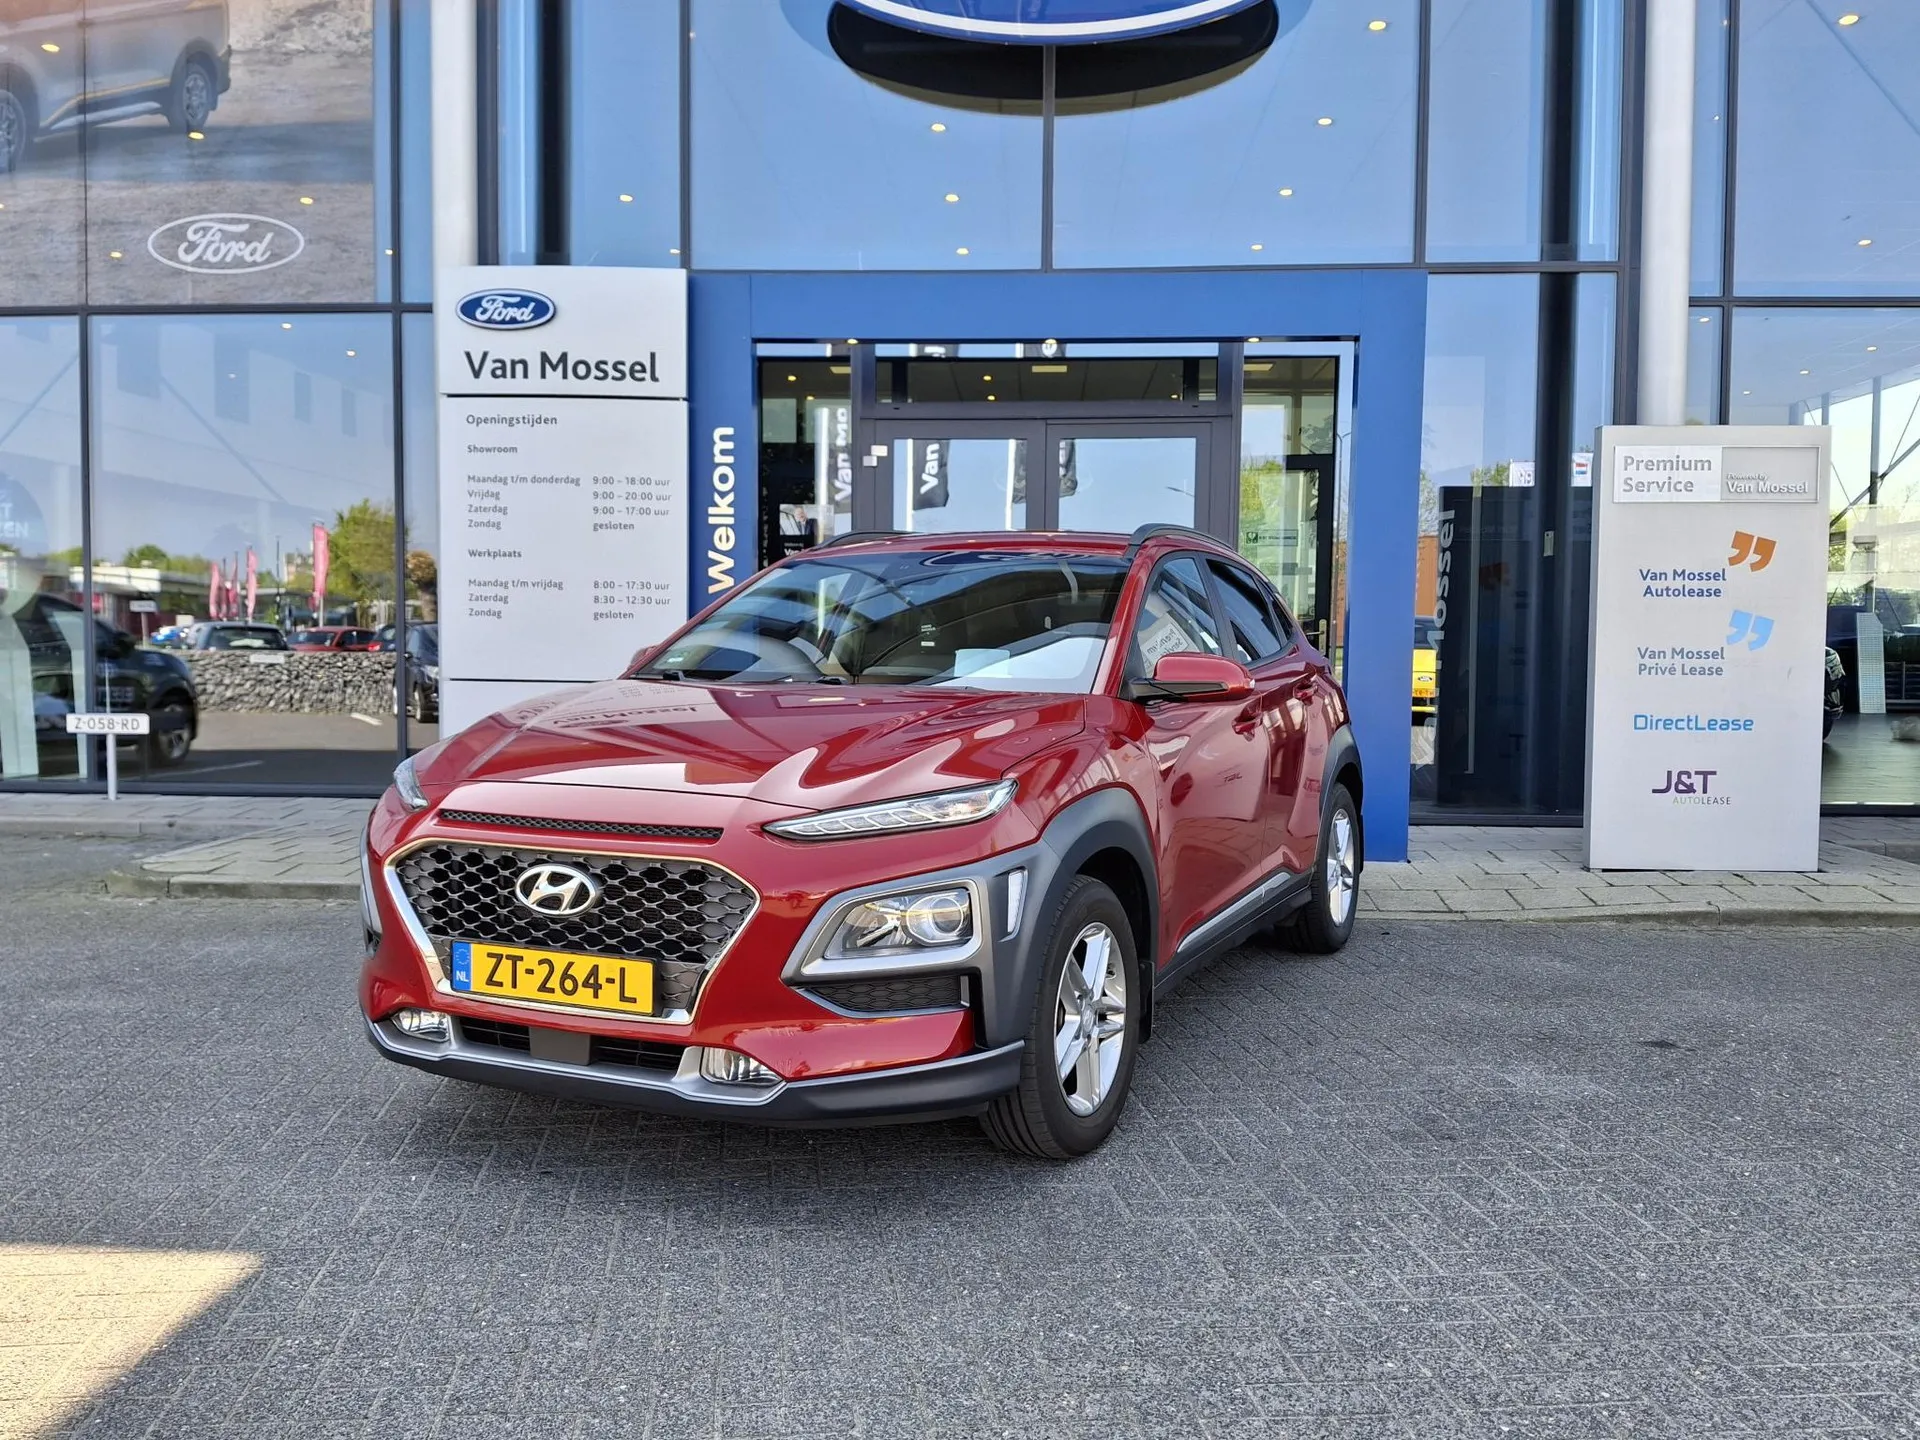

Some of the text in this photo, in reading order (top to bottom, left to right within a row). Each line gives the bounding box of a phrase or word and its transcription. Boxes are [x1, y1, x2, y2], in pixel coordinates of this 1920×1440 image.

[177, 221, 274, 263] Ford
[475, 295, 536, 322] Ford
[464, 351, 660, 383] Van Mossel
[466, 414, 558, 428] Openingstijden
[467, 444, 518, 454] Showroom
[920, 443, 940, 495] Van
[1622, 454, 1712, 471] Premium
[467, 475, 508, 486] Maandag
[510, 475, 528, 484] t/m
[530, 475, 581, 487] donderdag
[592, 476, 615, 485] 9:00
[625, 477, 652, 486] 18:00
[1622, 476, 1694, 493] Service
[1727, 481, 1809, 493] Van Mossel
[467, 490, 500, 501] Vrijdag
[592, 491, 615, 500] 9:00
[625, 492, 653, 501] 20:00
[467, 505, 508, 516] Zaterdag
[592, 506, 615, 515] 9:00
[625, 507, 651, 516] 17:00
[707, 426, 736, 595] Welkom
[467, 519, 635, 531] Zondag gesloten
[468, 549, 522, 560] Werkplaats
[1639, 568, 1727, 582] Van Mossel
[468, 579, 509, 589] Maandag
[511, 579, 529, 588] t/m
[530, 579, 564, 591] vrijdag
[593, 580, 615, 590] 8:00
[626, 581, 652, 590] 17:30
[1643, 584, 1722, 598] Autolease
[468, 593, 509, 604] Zaterdag
[593, 595, 615, 605] 8:30
[626, 596, 652, 605] 12:30
[468, 608, 634, 620] Zondag gesloten
[1637, 646, 1725, 660] Van Mossel
[1638, 663, 1724, 676] Privé Lease
[1633, 714, 1754, 731] DirectLease
[1651, 770, 1717, 795] J&T
[1672, 796, 1731, 805] AUTOLEASE
[455, 969, 470, 982] NL
[485, 952, 637, 1004] ZT-264-L
